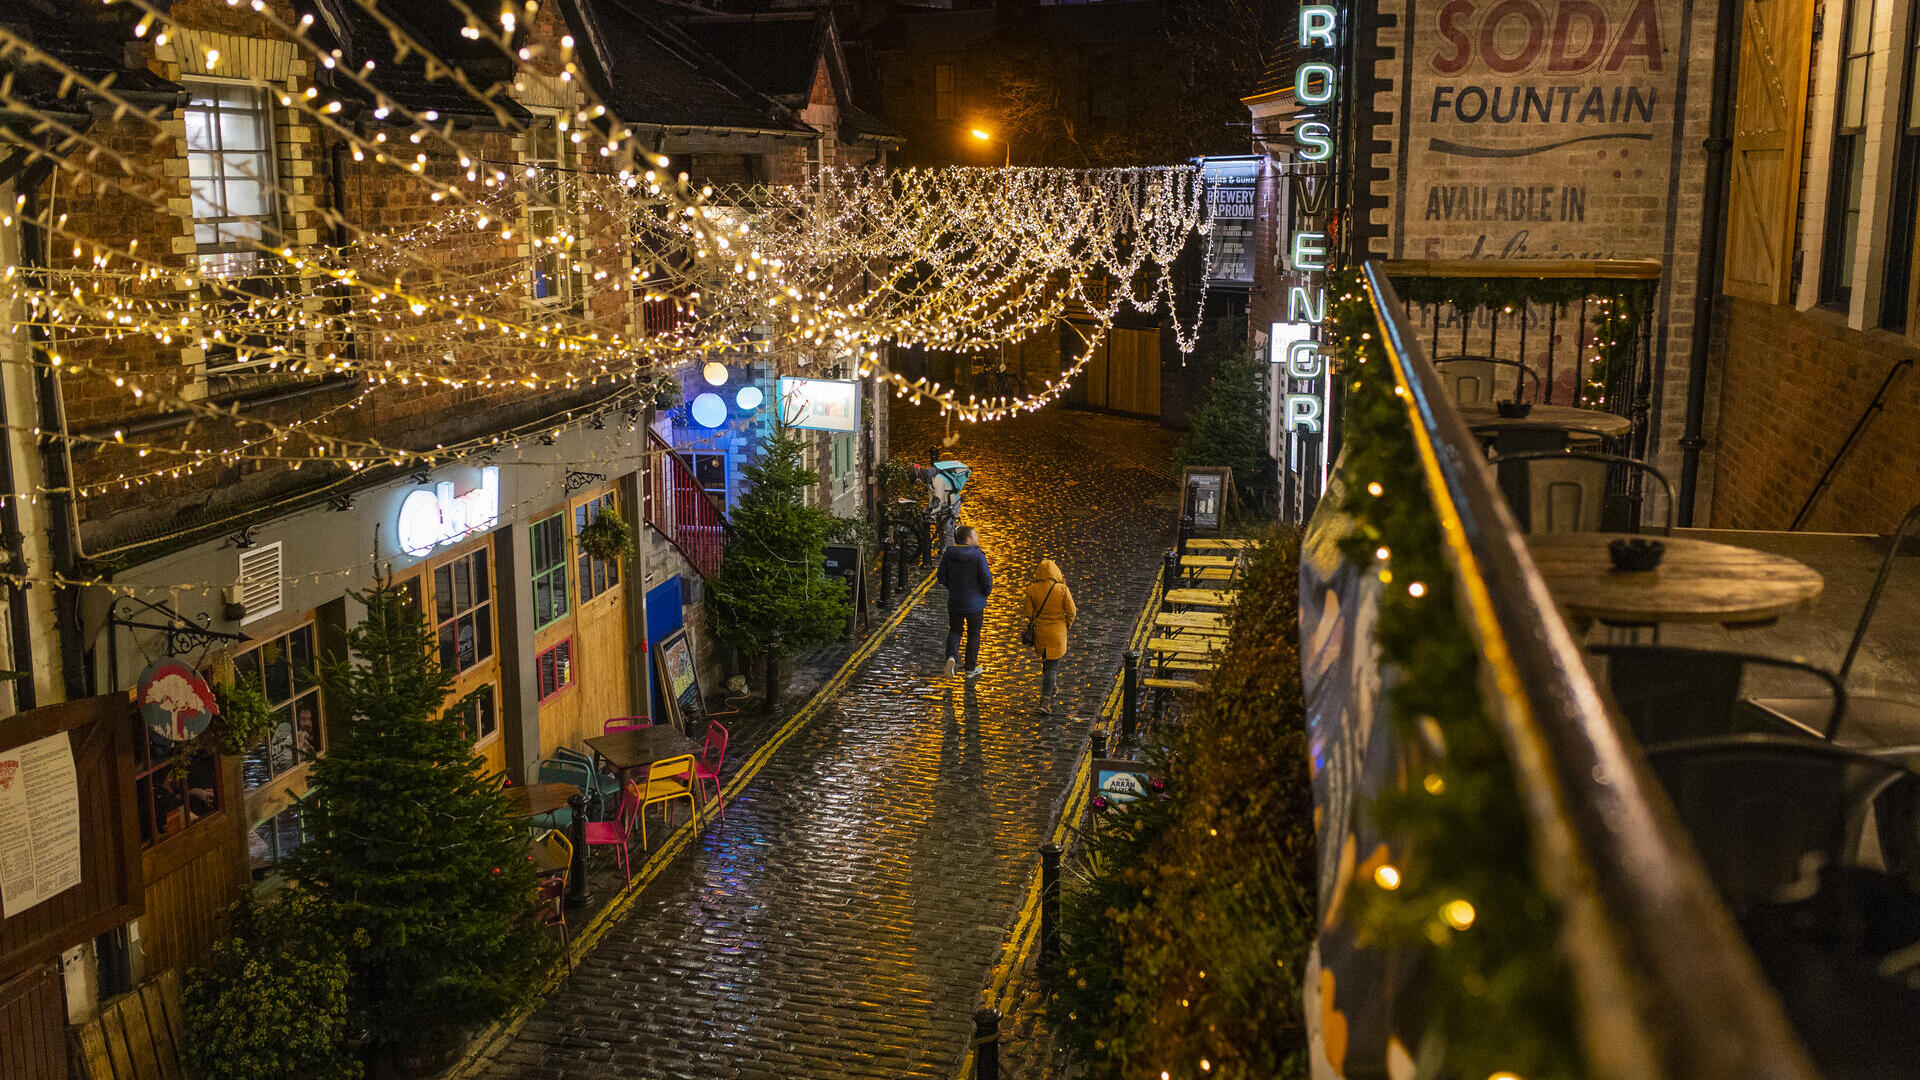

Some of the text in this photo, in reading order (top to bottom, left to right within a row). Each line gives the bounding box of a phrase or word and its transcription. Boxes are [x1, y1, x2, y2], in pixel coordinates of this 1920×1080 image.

[1432, 0, 1664, 73] SODA
[1430, 86, 1657, 123] FOUNTAIN
[1207, 190, 1256, 204] BREWERY
[1425, 186, 1587, 222] AVAILABLE IN
